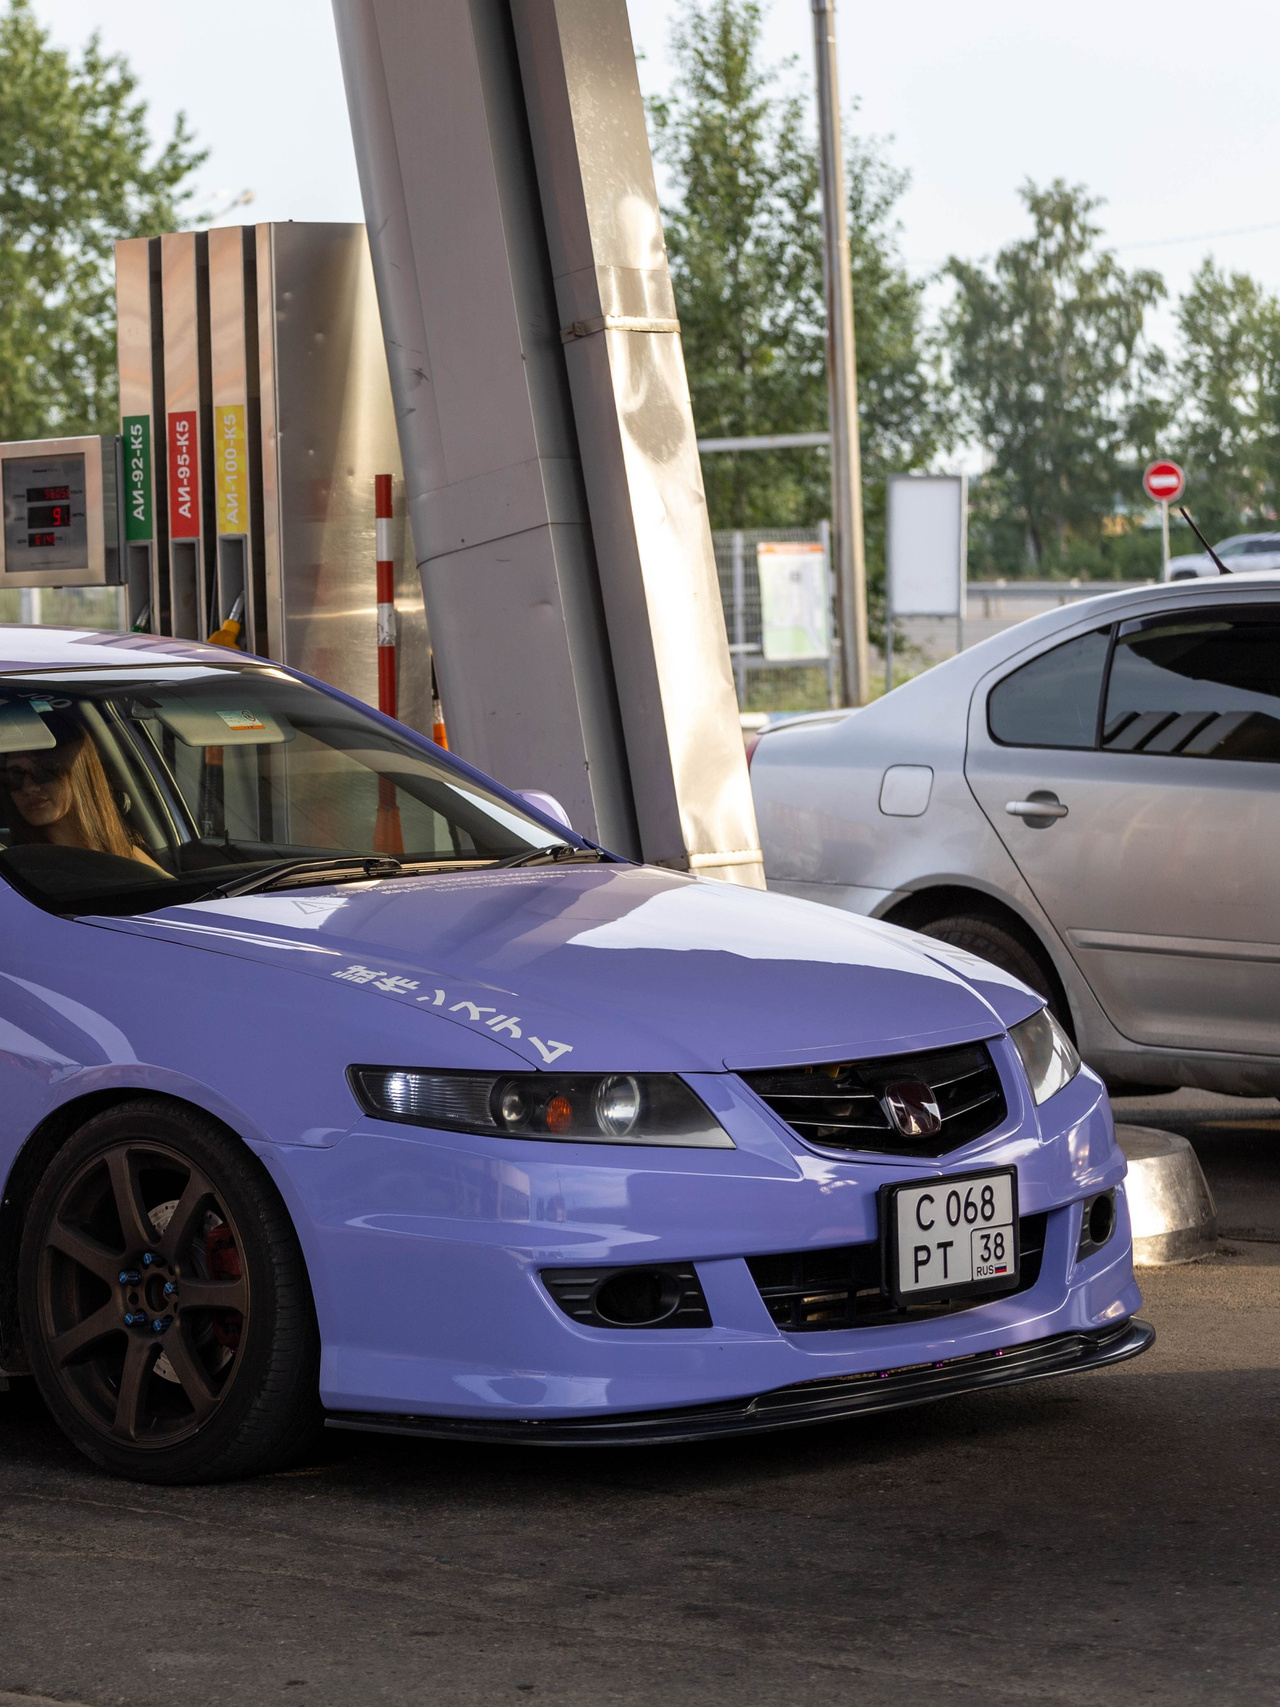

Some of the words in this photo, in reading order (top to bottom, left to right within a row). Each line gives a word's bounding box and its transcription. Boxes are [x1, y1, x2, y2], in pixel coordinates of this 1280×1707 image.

[130, 424, 145, 521] АИ-92-К5
[176, 420, 191, 518] АИ-95-К5
[223, 414, 239, 524] АИ-100-К5
[916, 1193, 935, 1231] С
[946, 1185, 995, 1226] 068
[914, 1240, 954, 1284] РТ
[977, 1264, 994, 1276] RUS
[980, 1232, 1005, 1262] 38
